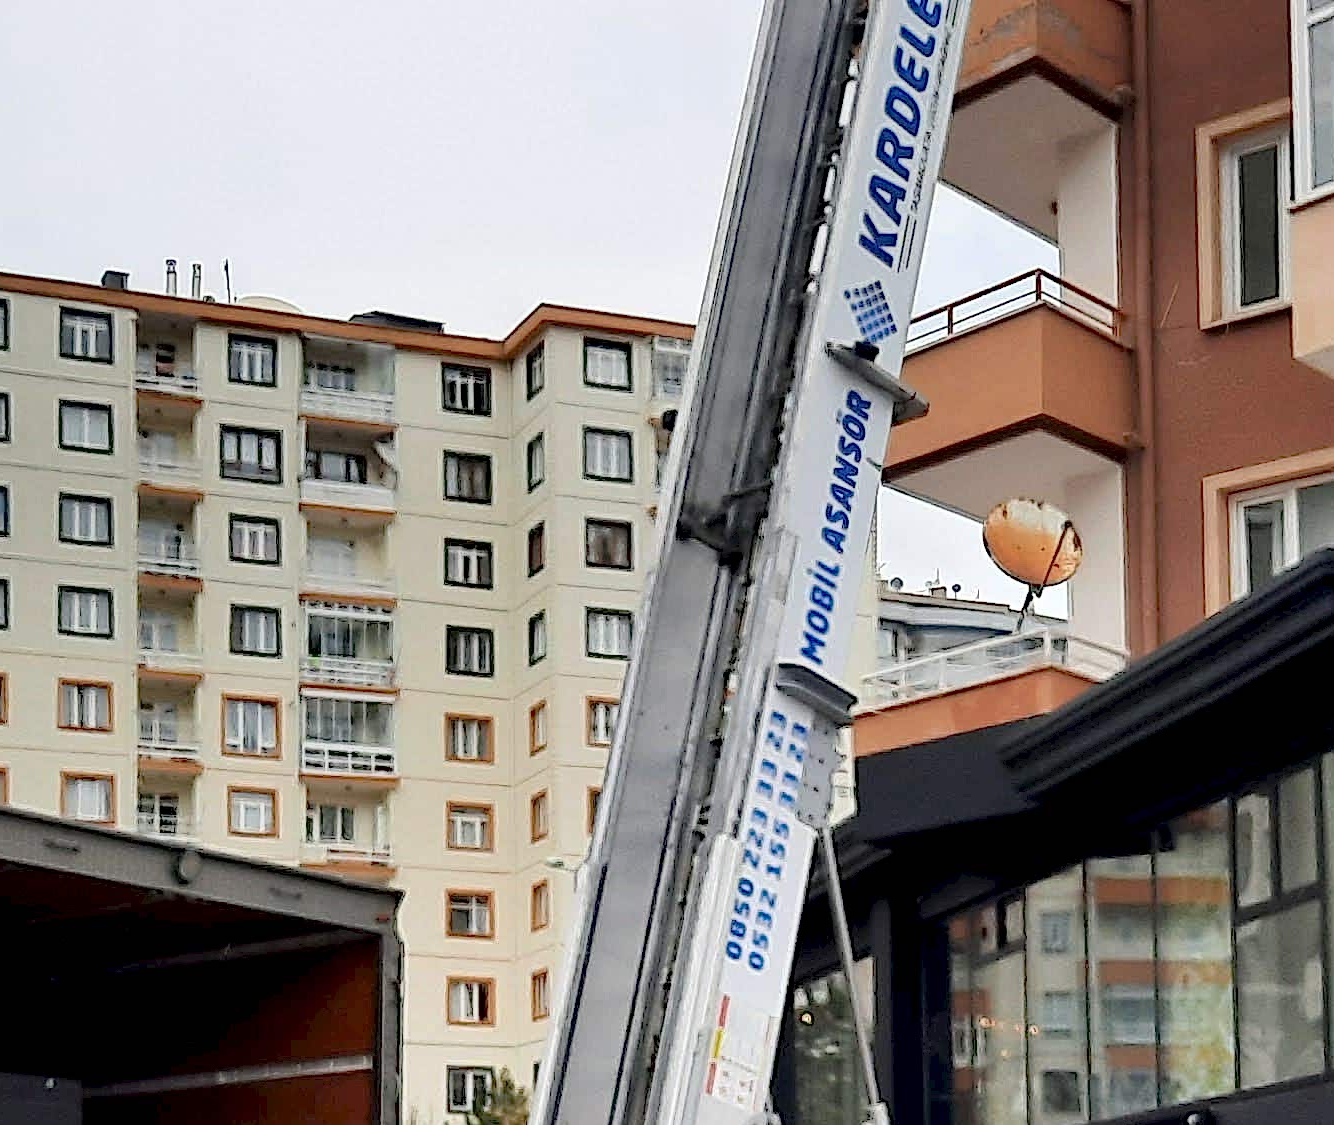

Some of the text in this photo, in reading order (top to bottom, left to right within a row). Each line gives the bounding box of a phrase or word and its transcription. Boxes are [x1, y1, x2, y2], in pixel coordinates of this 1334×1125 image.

[799, 389, 872, 666] MOBİL ASANSÖR
[726, 877, 755, 960] 0850
[742, 807, 768, 869] 223
[748, 888, 778, 971] 0532
[766, 819, 790, 880] 155
